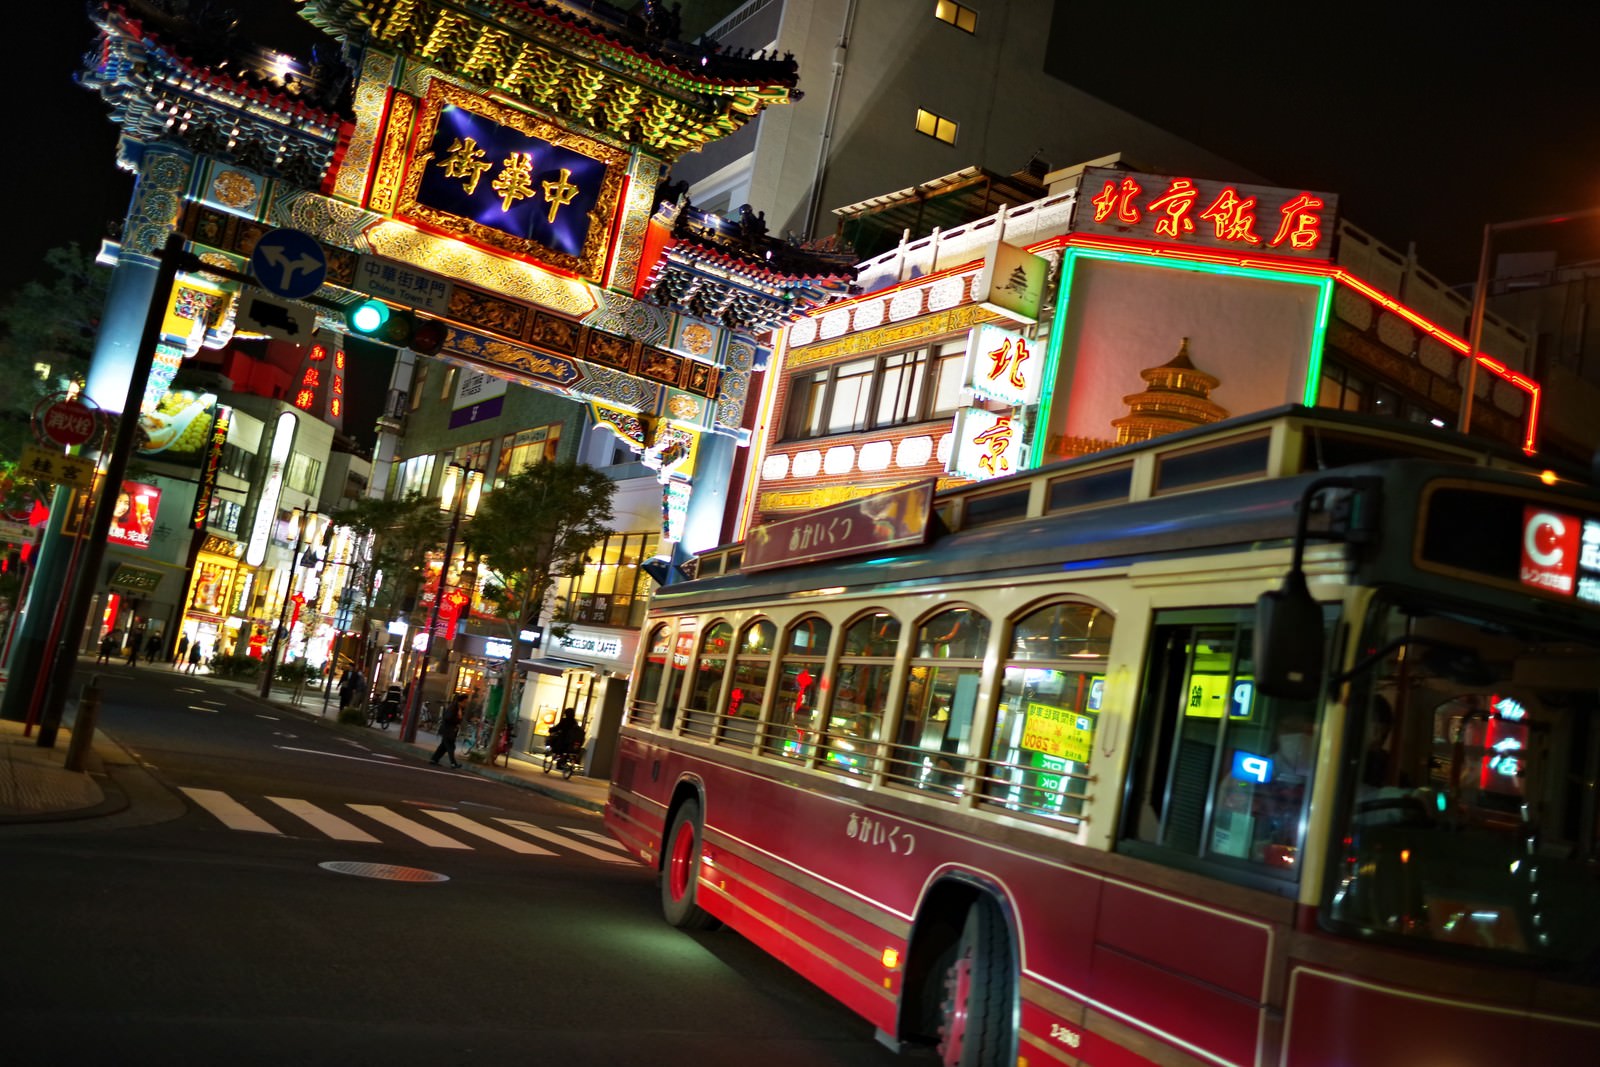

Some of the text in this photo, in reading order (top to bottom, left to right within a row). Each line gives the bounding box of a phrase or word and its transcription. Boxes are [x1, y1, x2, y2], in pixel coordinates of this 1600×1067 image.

[1090, 178, 1326, 250] 北京飯店
[364, 261, 446, 300] 中華街東門
[369, 280, 386, 295] China
[400, 289, 424, 303] Town
[47, 408, 93, 436] 消火栓
[789, 517, 852, 551] あかいくつ
[1524, 513, 1566, 567] C
[846, 812, 916, 856] あかいくつ
